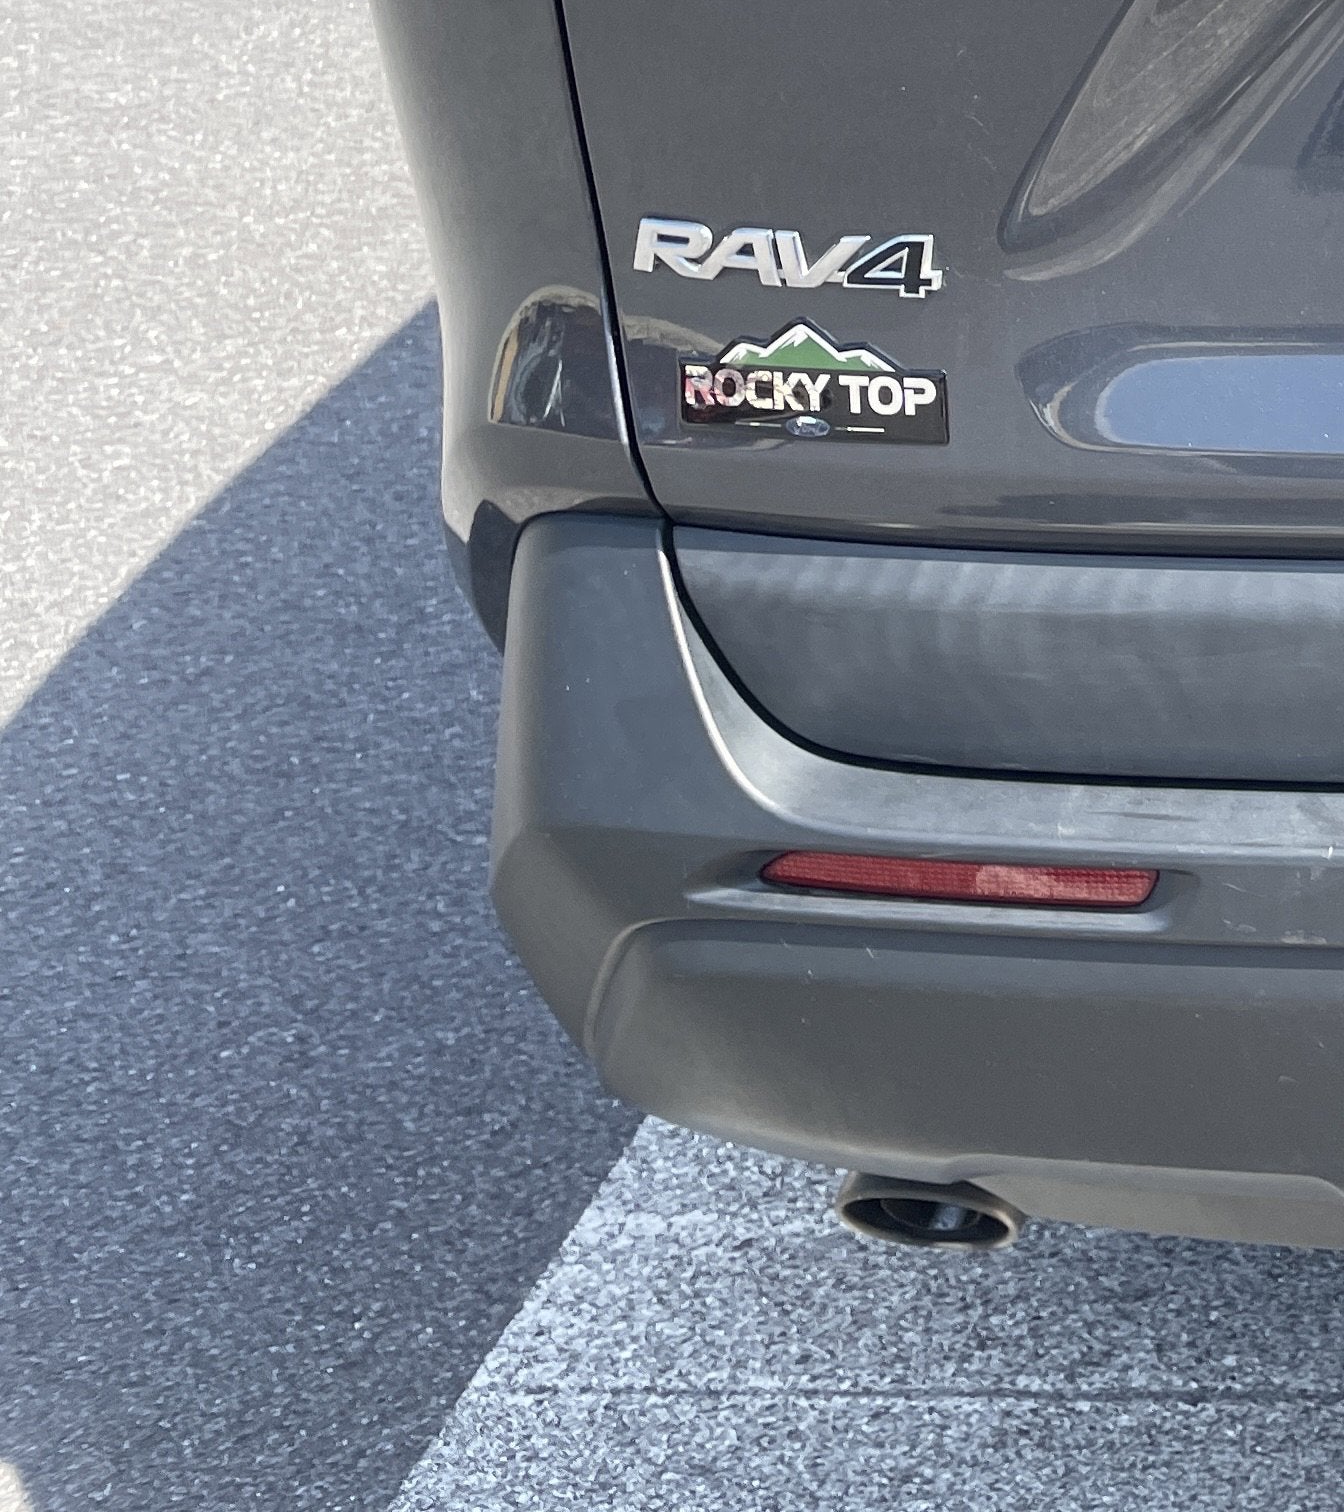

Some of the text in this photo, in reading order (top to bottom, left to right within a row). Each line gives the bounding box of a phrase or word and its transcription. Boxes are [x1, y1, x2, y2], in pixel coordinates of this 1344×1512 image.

[633, 217, 944, 298] RAV4
[685, 365, 937, 416] ROCKY TOP
